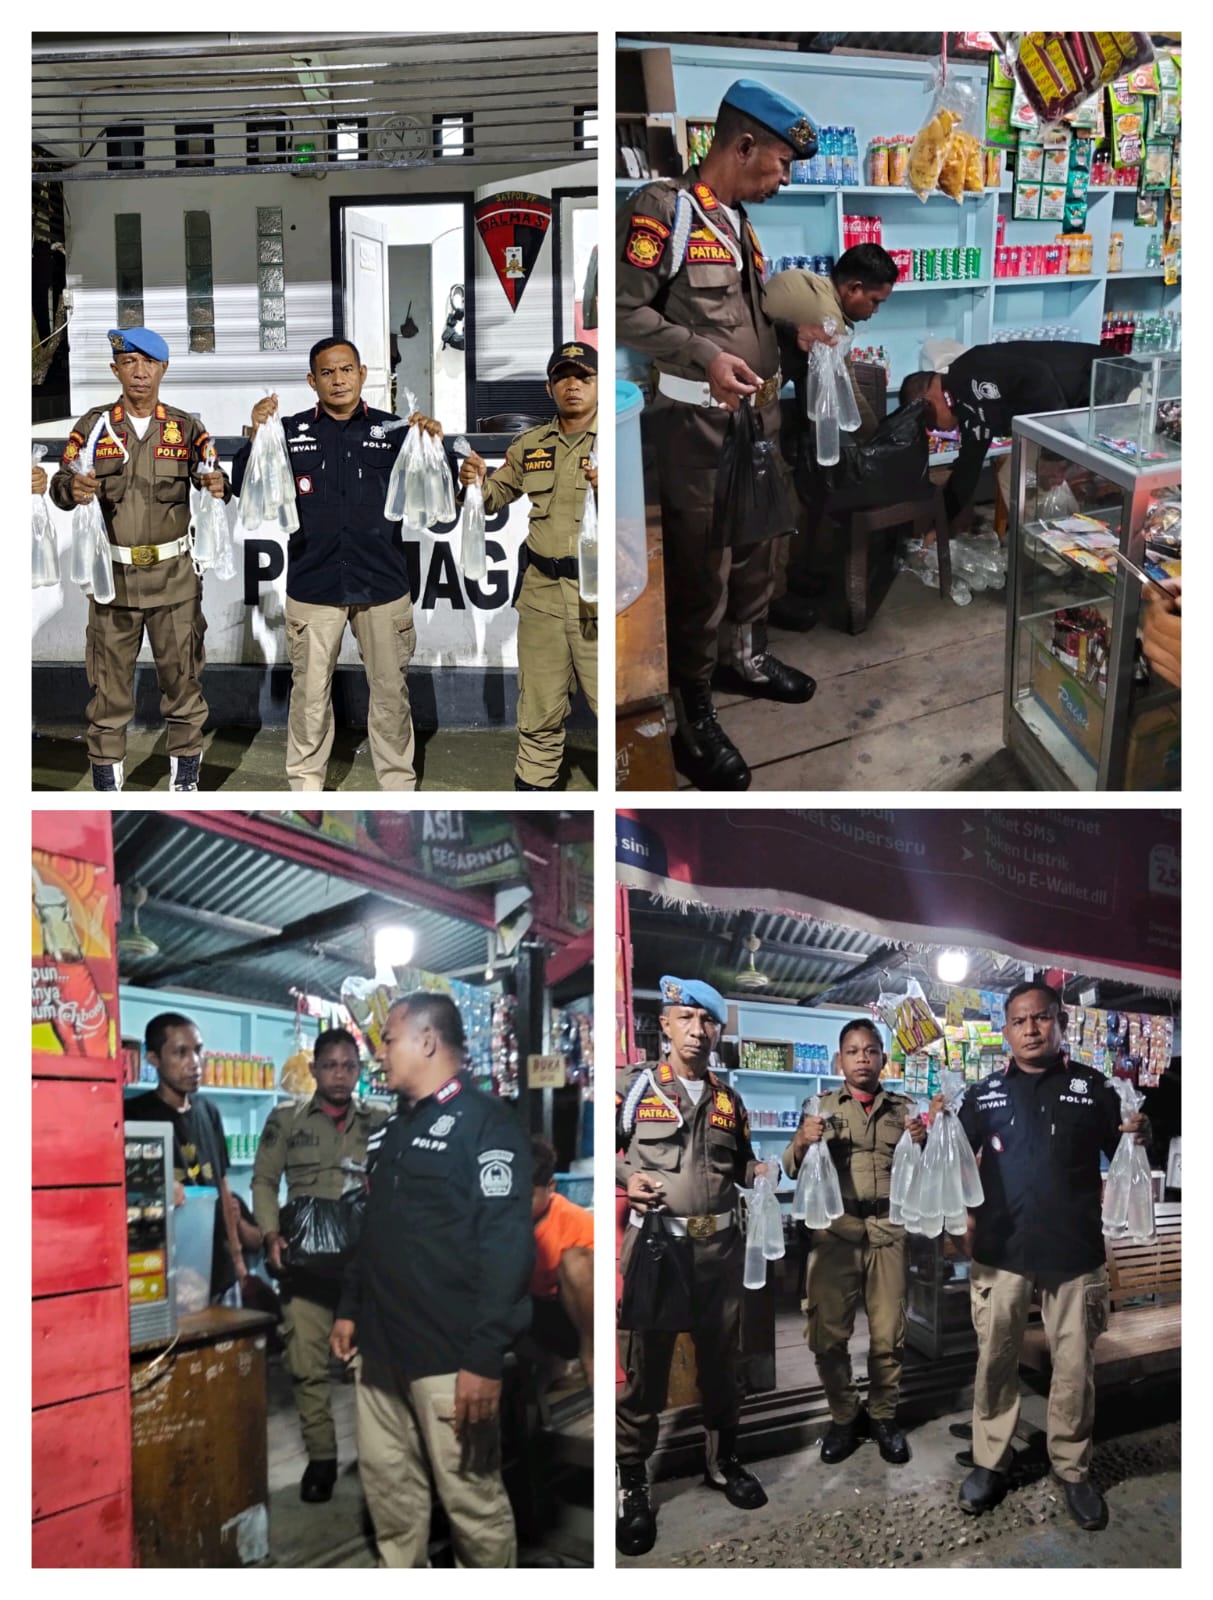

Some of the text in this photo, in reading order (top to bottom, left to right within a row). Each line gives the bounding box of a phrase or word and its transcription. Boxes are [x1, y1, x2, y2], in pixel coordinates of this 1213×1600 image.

[495, 193, 524, 202] SATPOL
[477, 213, 546, 233] DALMAS
[690, 246, 732, 260] PATRAS
[362, 441, 380, 449] POL
[96, 449, 124, 458] PATRAS
[157, 448, 187, 457] POL PP
[524, 460, 553, 471] YANTO
[422, 810, 465, 841] ASLI
[1022, 820, 1056, 845] SMS
[829, 813, 926, 856] Superseru
[621, 836, 650, 857] sini
[983, 825, 1071, 873] Token Listrik
[432, 841, 515, 871] SEGARNYA
[983, 850, 1108, 905] Top Up E-Wallet dll
[1059, 1095, 1093, 1105] POL PP
[638, 1107, 677, 1119] PATRAS
[712, 1115, 729, 1128] POL
